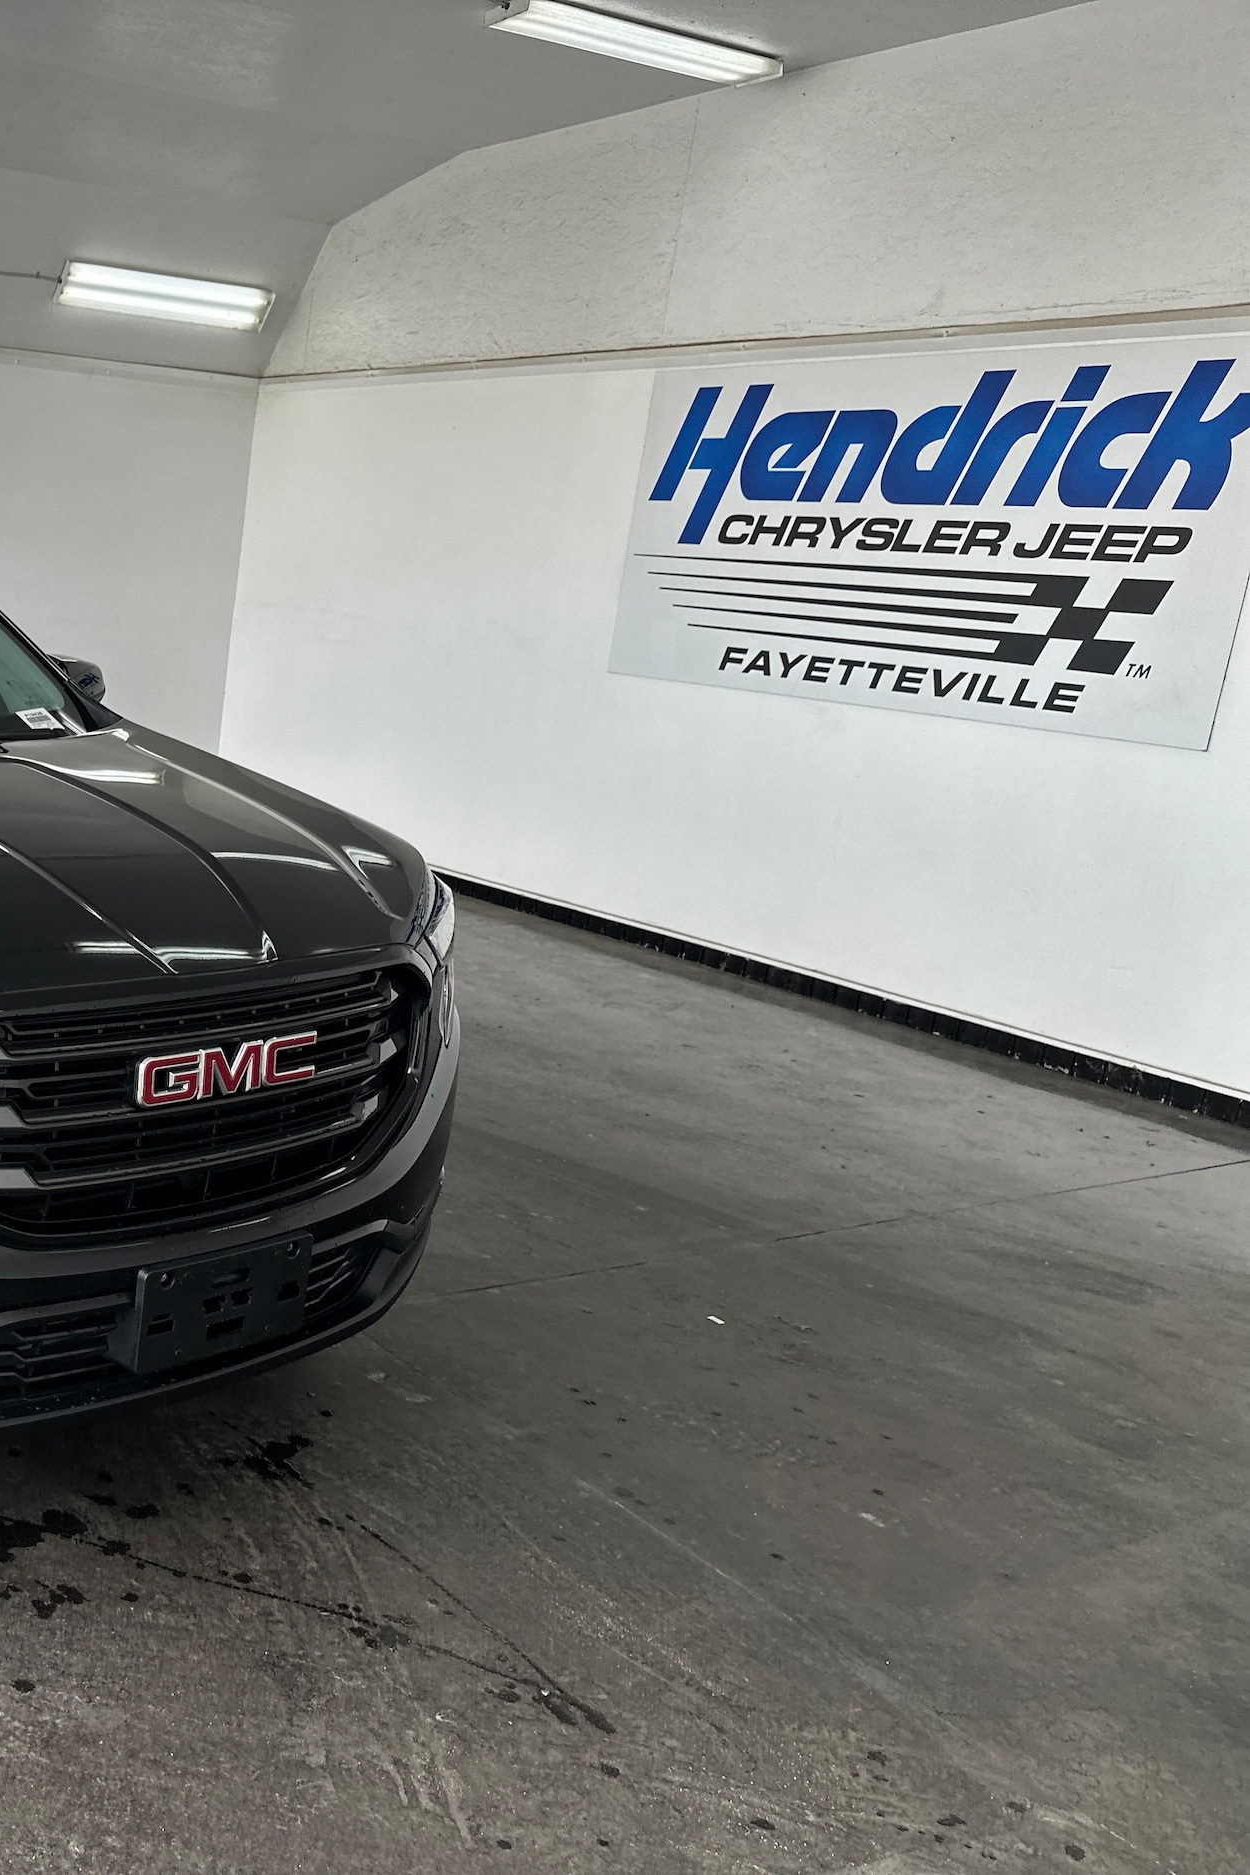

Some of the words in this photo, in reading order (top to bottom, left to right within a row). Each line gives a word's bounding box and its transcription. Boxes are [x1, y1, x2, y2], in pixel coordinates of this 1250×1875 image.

[648, 358, 1250, 545] Hendrick
[717, 514, 1012, 557] CHRYSLER
[1012, 522, 1194, 563] JEEP
[717, 646, 1086, 714] FAYETTEVILLE
[1125, 663, 1152, 679] TM
[136, 1030, 317, 1107] GMC
